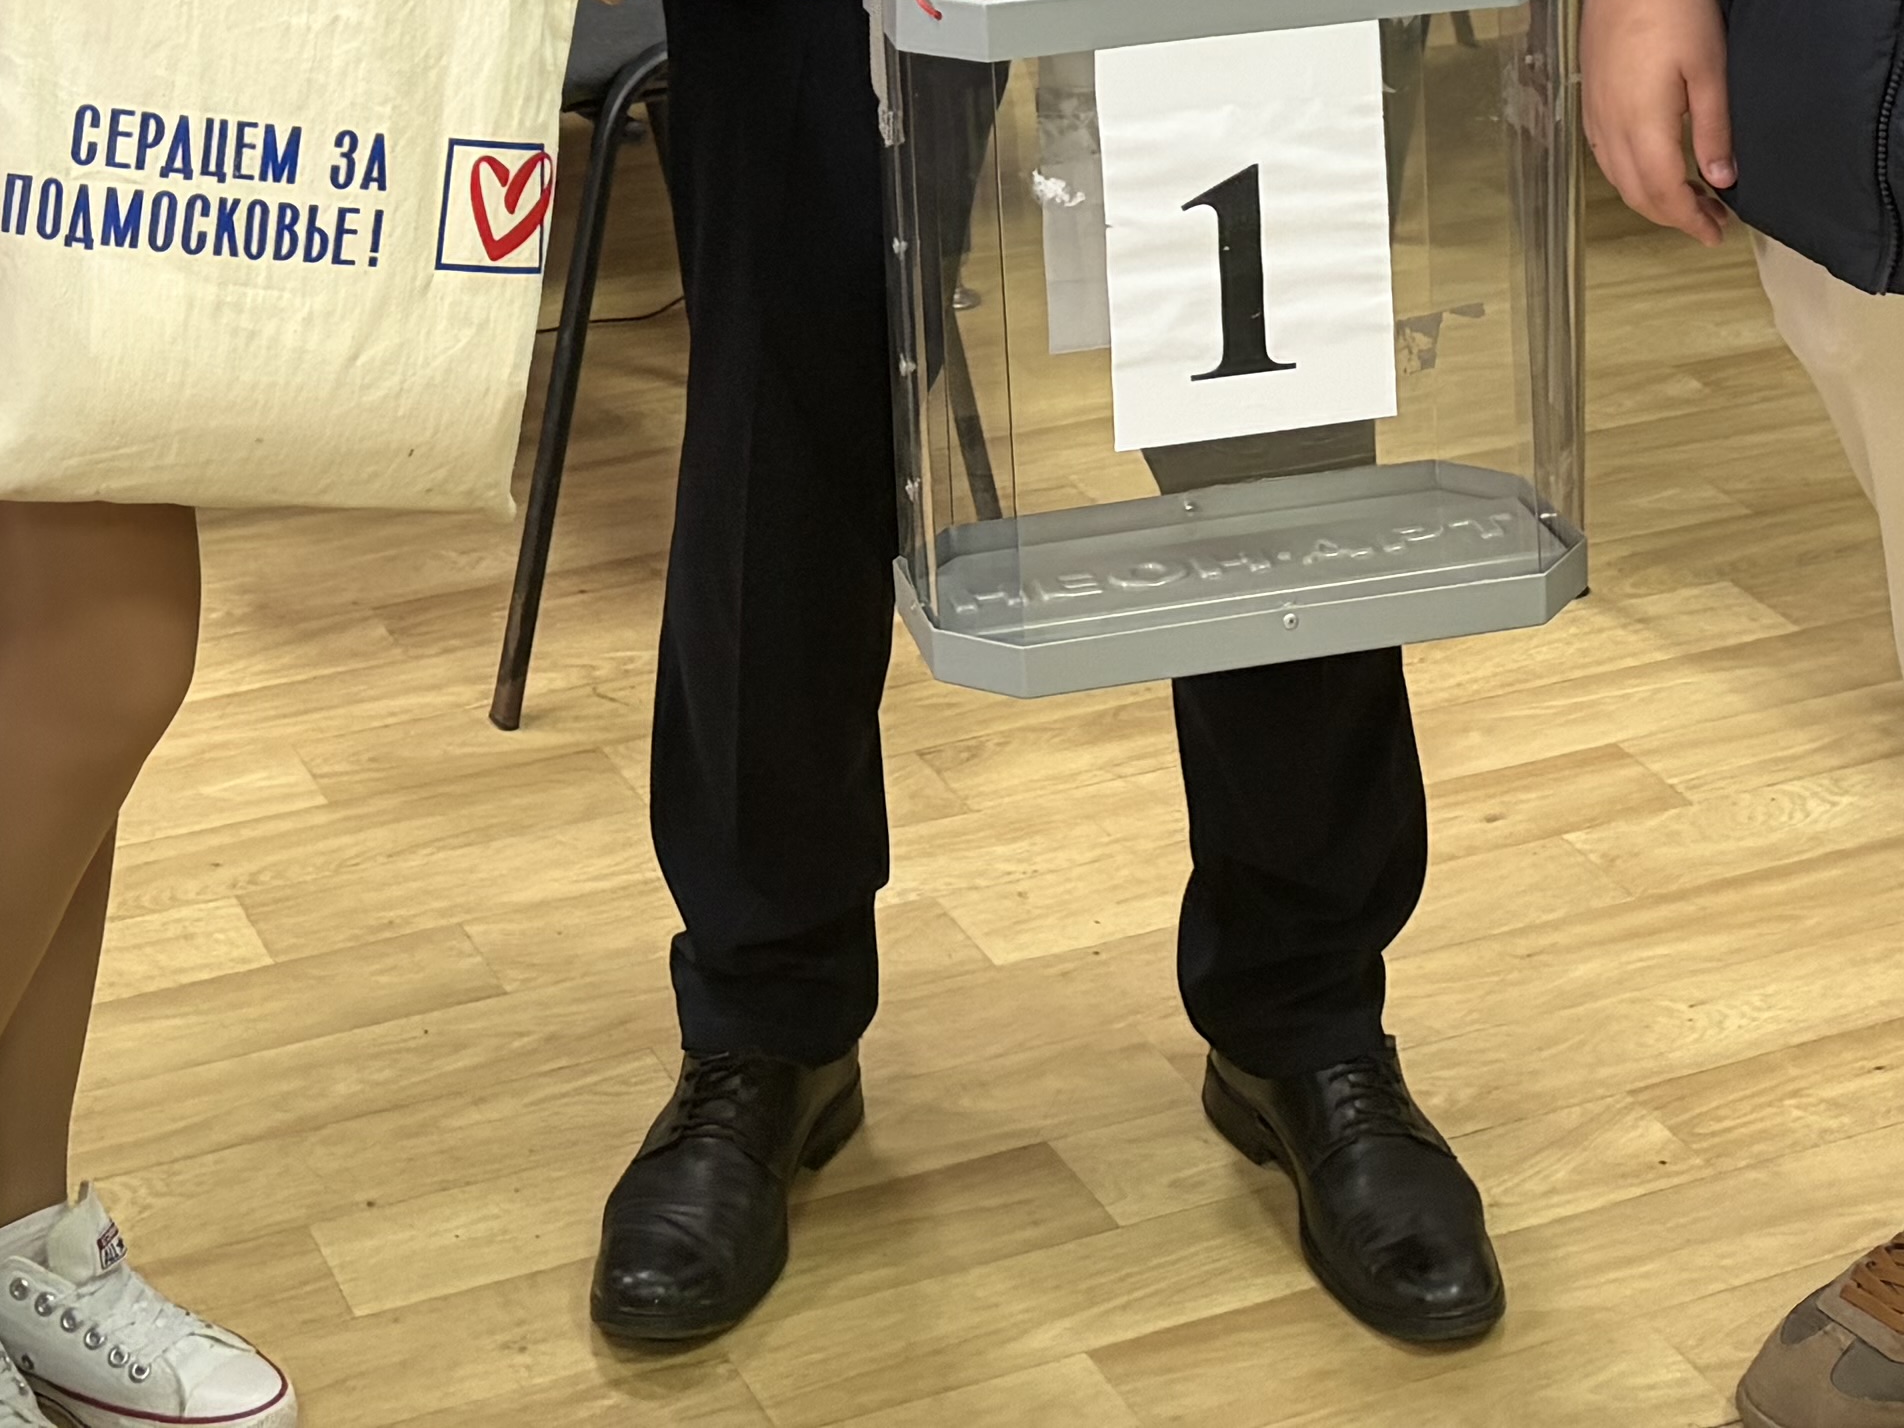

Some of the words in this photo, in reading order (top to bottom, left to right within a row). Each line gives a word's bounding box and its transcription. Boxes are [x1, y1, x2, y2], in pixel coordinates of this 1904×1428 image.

[70, 103, 301, 186] СЕРДЦЕМ
[328, 130, 389, 192] ЗА
[0, 172, 386, 268] ПОДМОСКОВЬЕ!
[1180, 162, 1298, 383] 1
